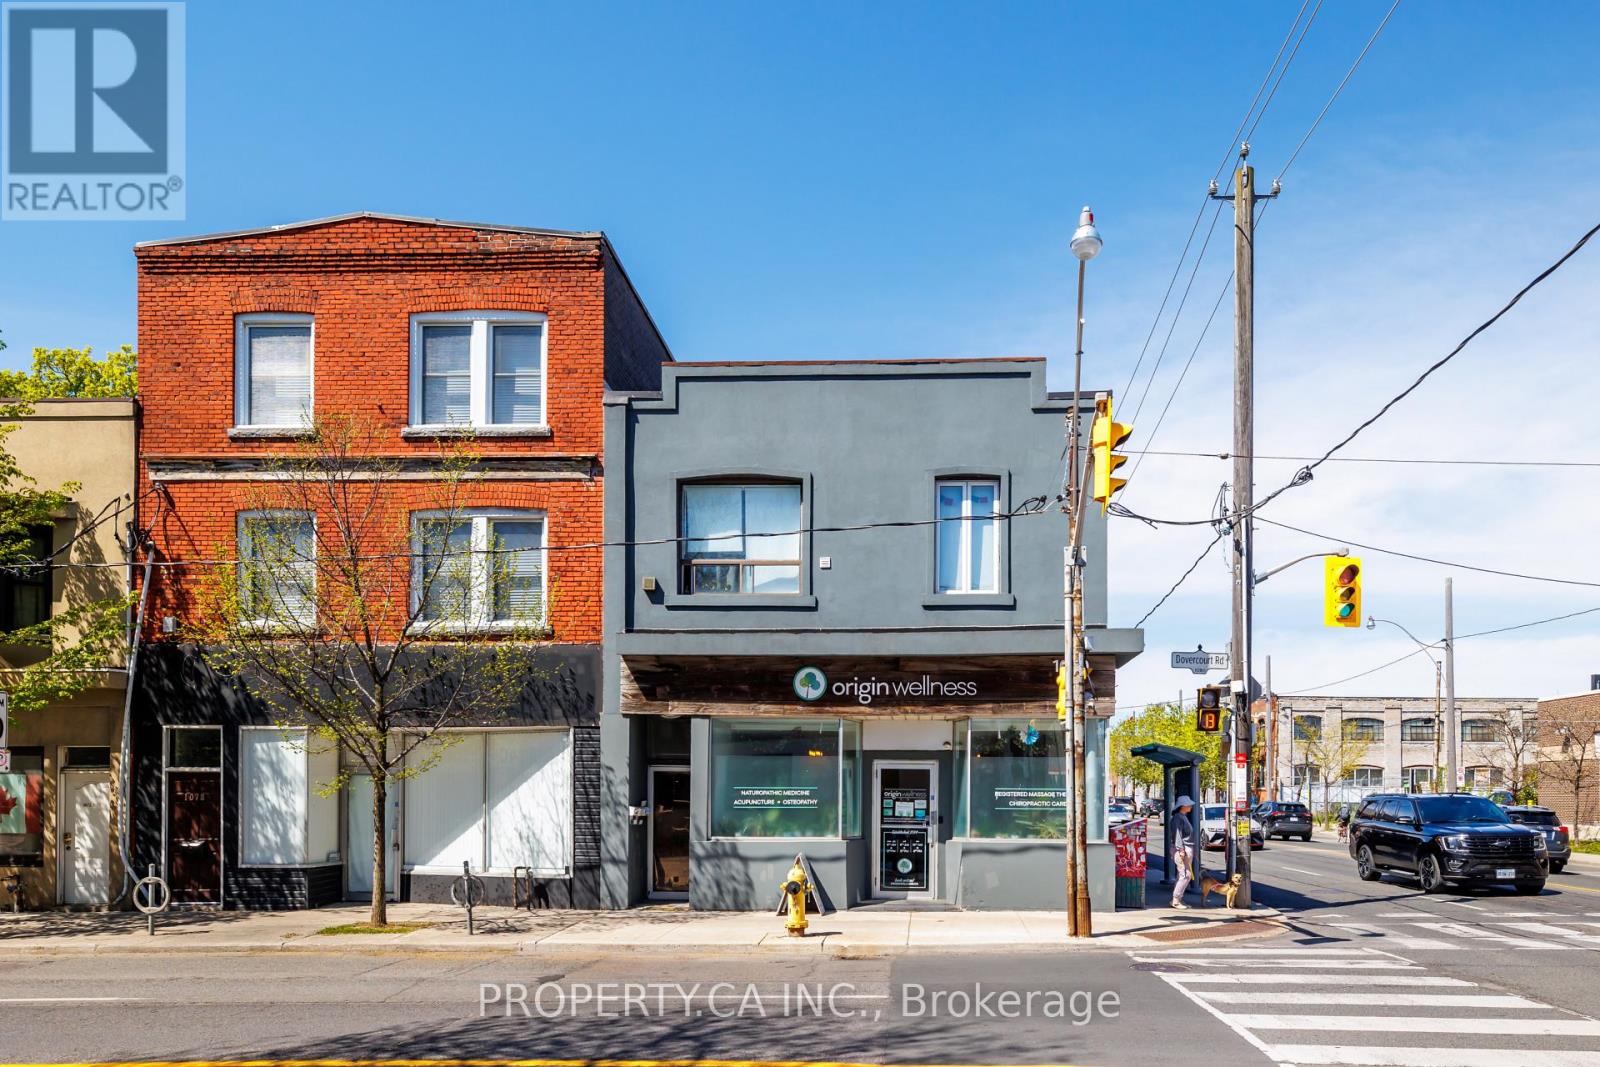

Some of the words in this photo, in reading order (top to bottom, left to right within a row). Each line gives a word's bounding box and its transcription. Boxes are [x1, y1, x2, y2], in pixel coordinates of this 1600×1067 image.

[1175, 654, 1213, 665] Dovercourt
[1215, 655, 1225, 665] Rd
[832, 676, 889, 704] origin
[892, 675, 977, 697] wellness
[883, 790, 902, 800] origin
